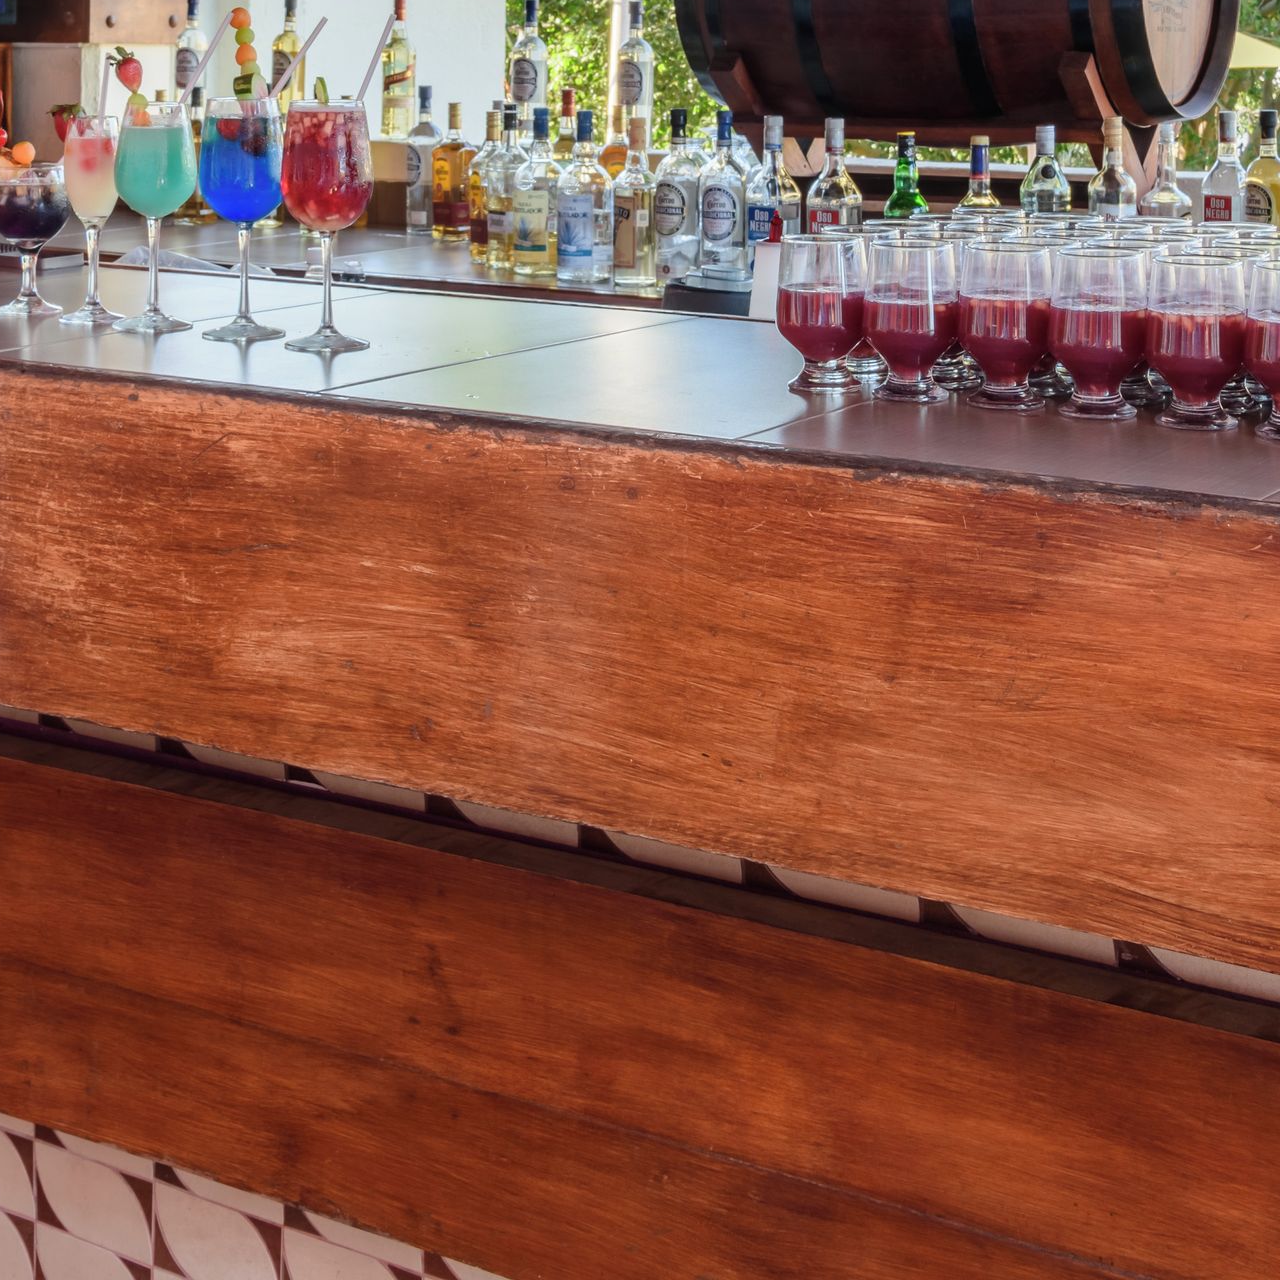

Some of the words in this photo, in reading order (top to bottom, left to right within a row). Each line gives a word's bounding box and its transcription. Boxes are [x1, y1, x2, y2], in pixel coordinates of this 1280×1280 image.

[1210, 198, 1225, 208] OSO
[754, 209, 769, 221] OSO
[816, 211, 832, 223] OSO
[1205, 208, 1230, 219] NEGRO
[749, 220, 770, 232] NEGR
